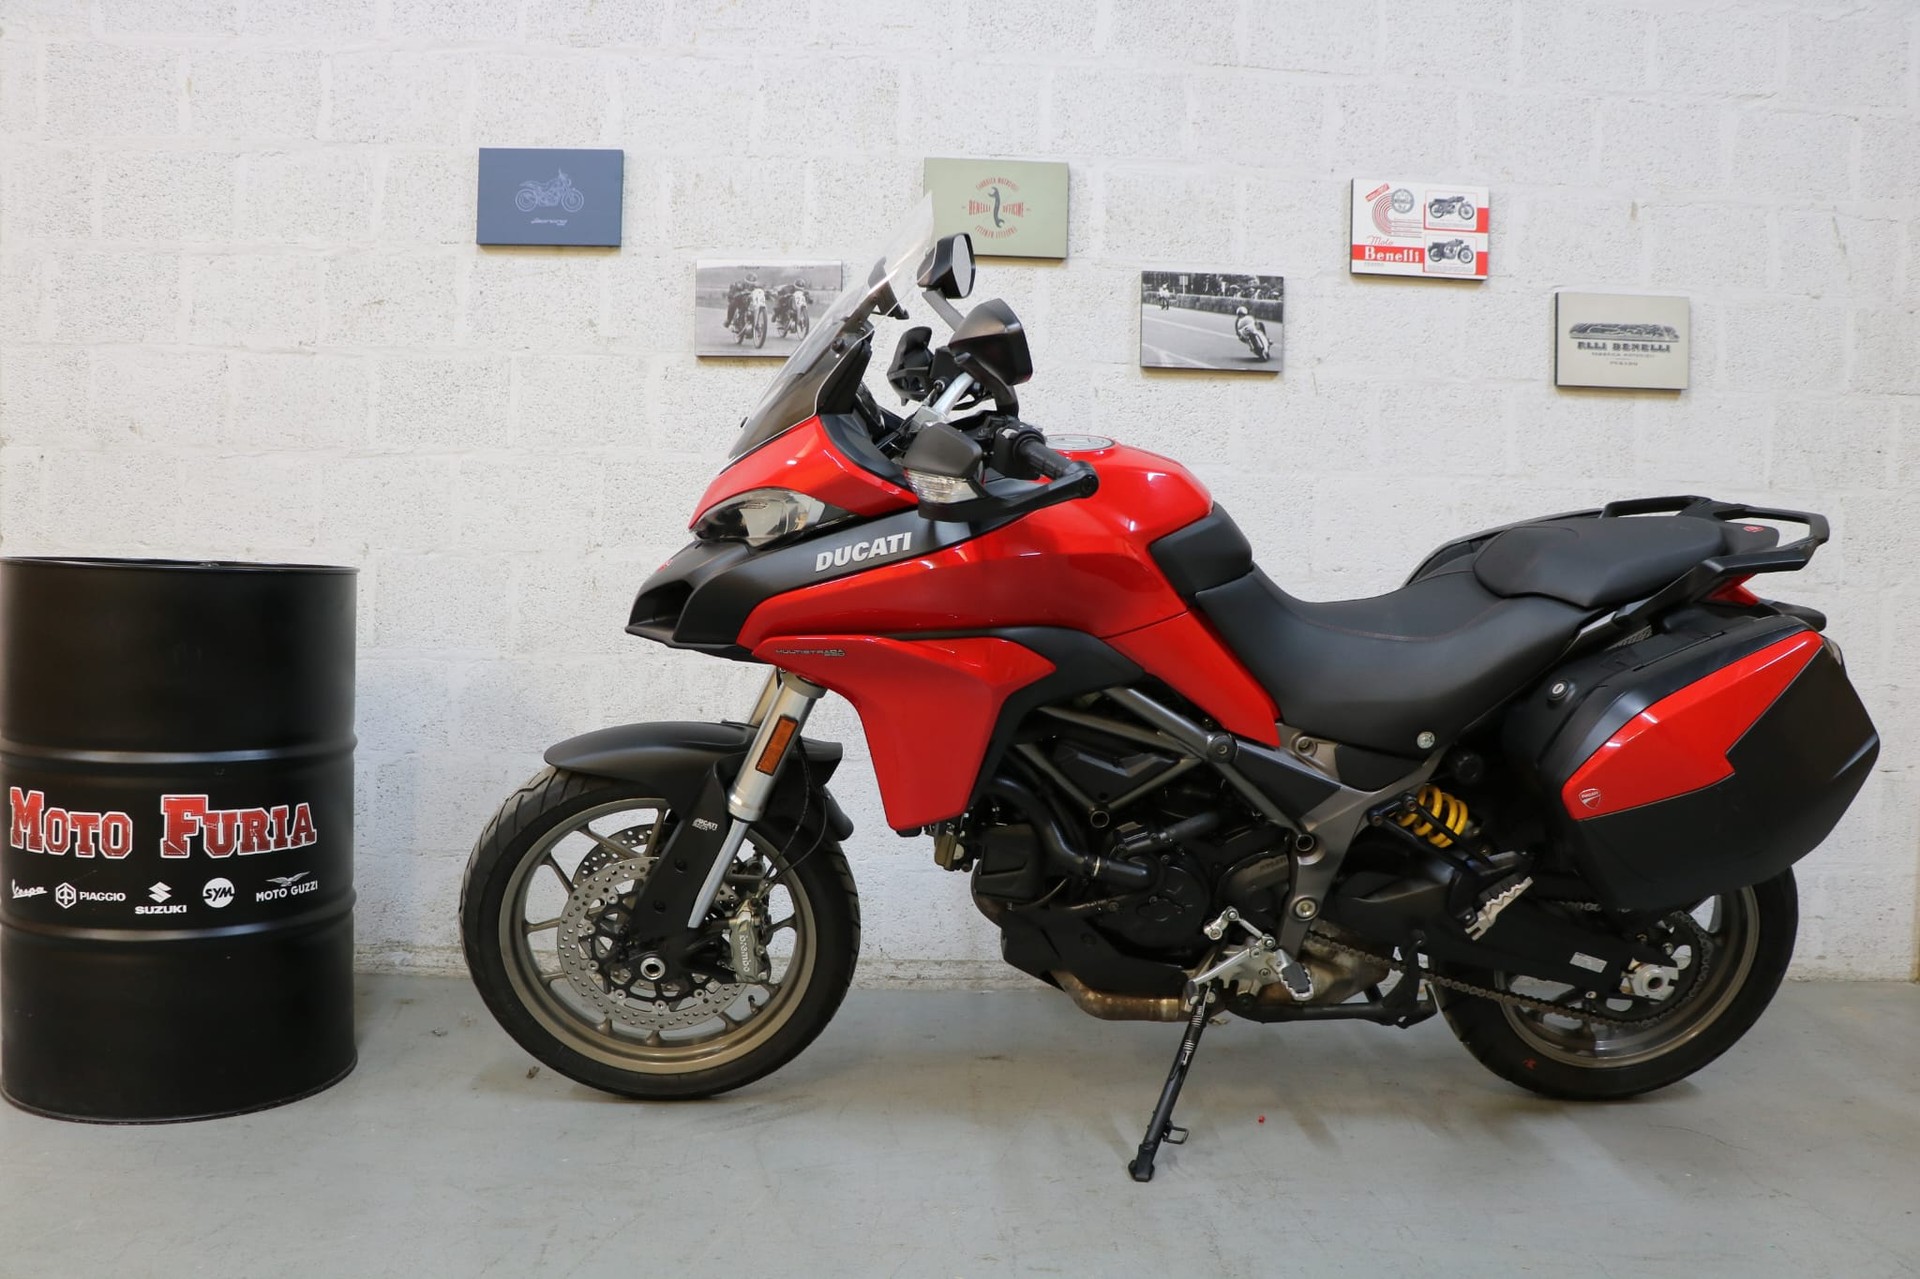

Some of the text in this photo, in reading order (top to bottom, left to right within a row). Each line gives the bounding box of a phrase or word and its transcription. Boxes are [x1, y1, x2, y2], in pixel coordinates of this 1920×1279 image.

[1364, 246, 1420, 262] Benelli
[815, 532, 912, 572] DUCATI
[79, 891, 126, 902] PIAGGIO
[202, 886, 235, 899] SYM
[256, 880, 318, 902] MOTO GUZZI
[135, 904, 187, 915] SUZUKI
[739, 934, 751, 973] brembo
